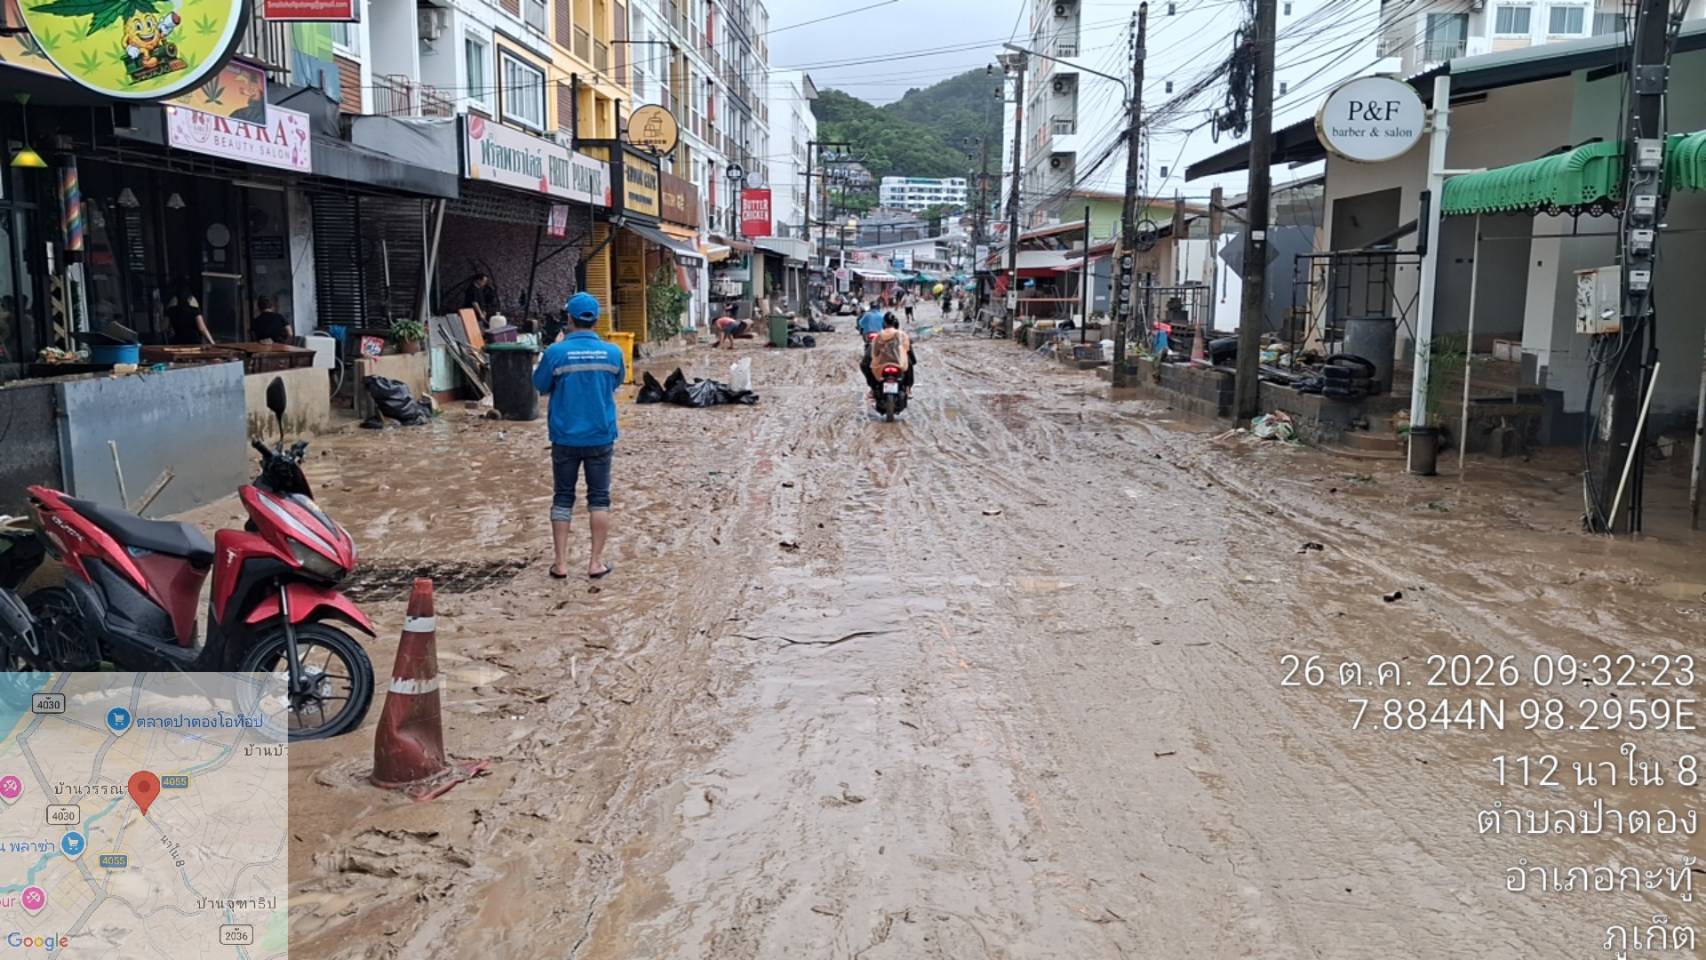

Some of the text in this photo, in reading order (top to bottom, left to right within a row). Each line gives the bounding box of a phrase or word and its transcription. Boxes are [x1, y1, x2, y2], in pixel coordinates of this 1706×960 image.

[1348, 100, 1401, 121] P&F
[1332, 126, 1413, 137] barber & salon
[214, 135, 290, 159] BEAUTY SALON
